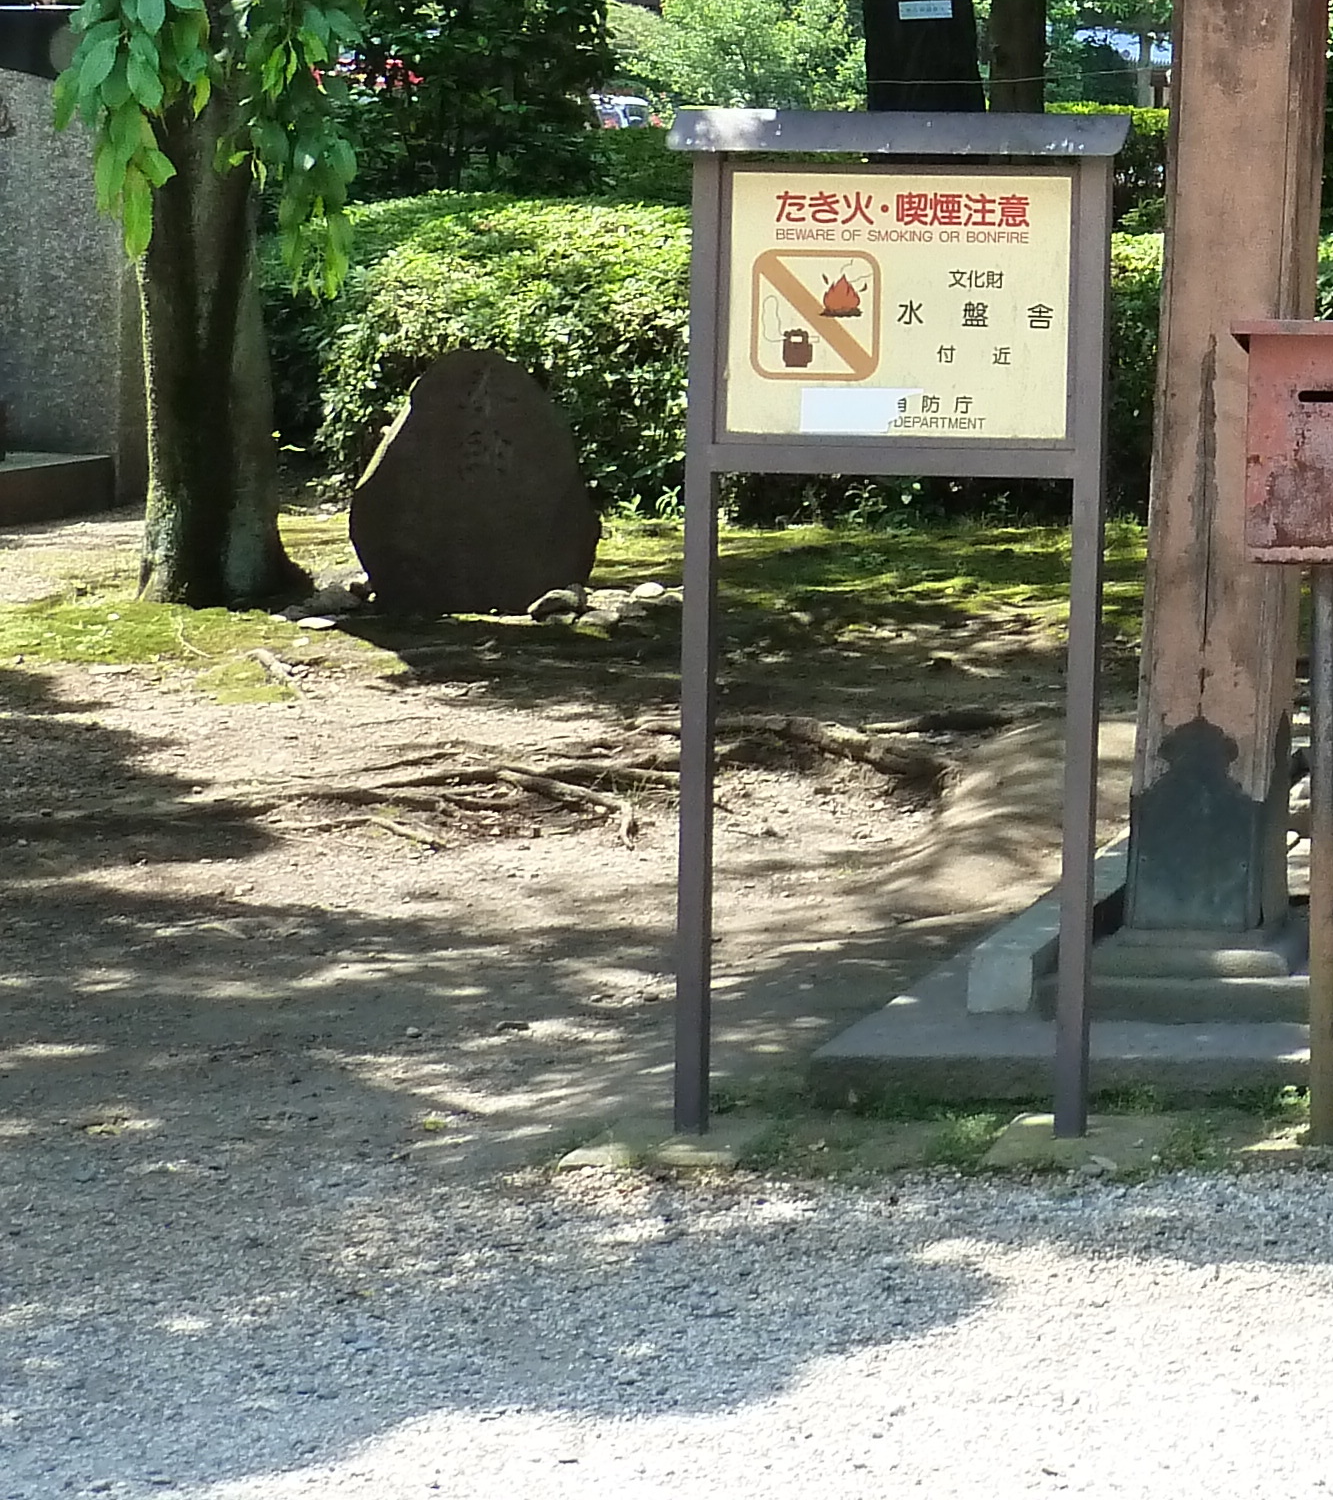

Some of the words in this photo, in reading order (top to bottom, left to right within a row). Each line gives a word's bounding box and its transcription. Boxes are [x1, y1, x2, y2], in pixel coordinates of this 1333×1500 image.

[775, 190, 1030, 228] たき火・喫煙注意
[775, 228, 836, 241] BEWARE
[841, 229, 862, 242] OF
[866, 229, 933, 243] SMOKING
[939, 230, 960, 243] OR
[966, 230, 1030, 244] BONFIRE
[948, 269, 1004, 289] 文化財
[893, 416, 986, 430] DEPARTMENT
